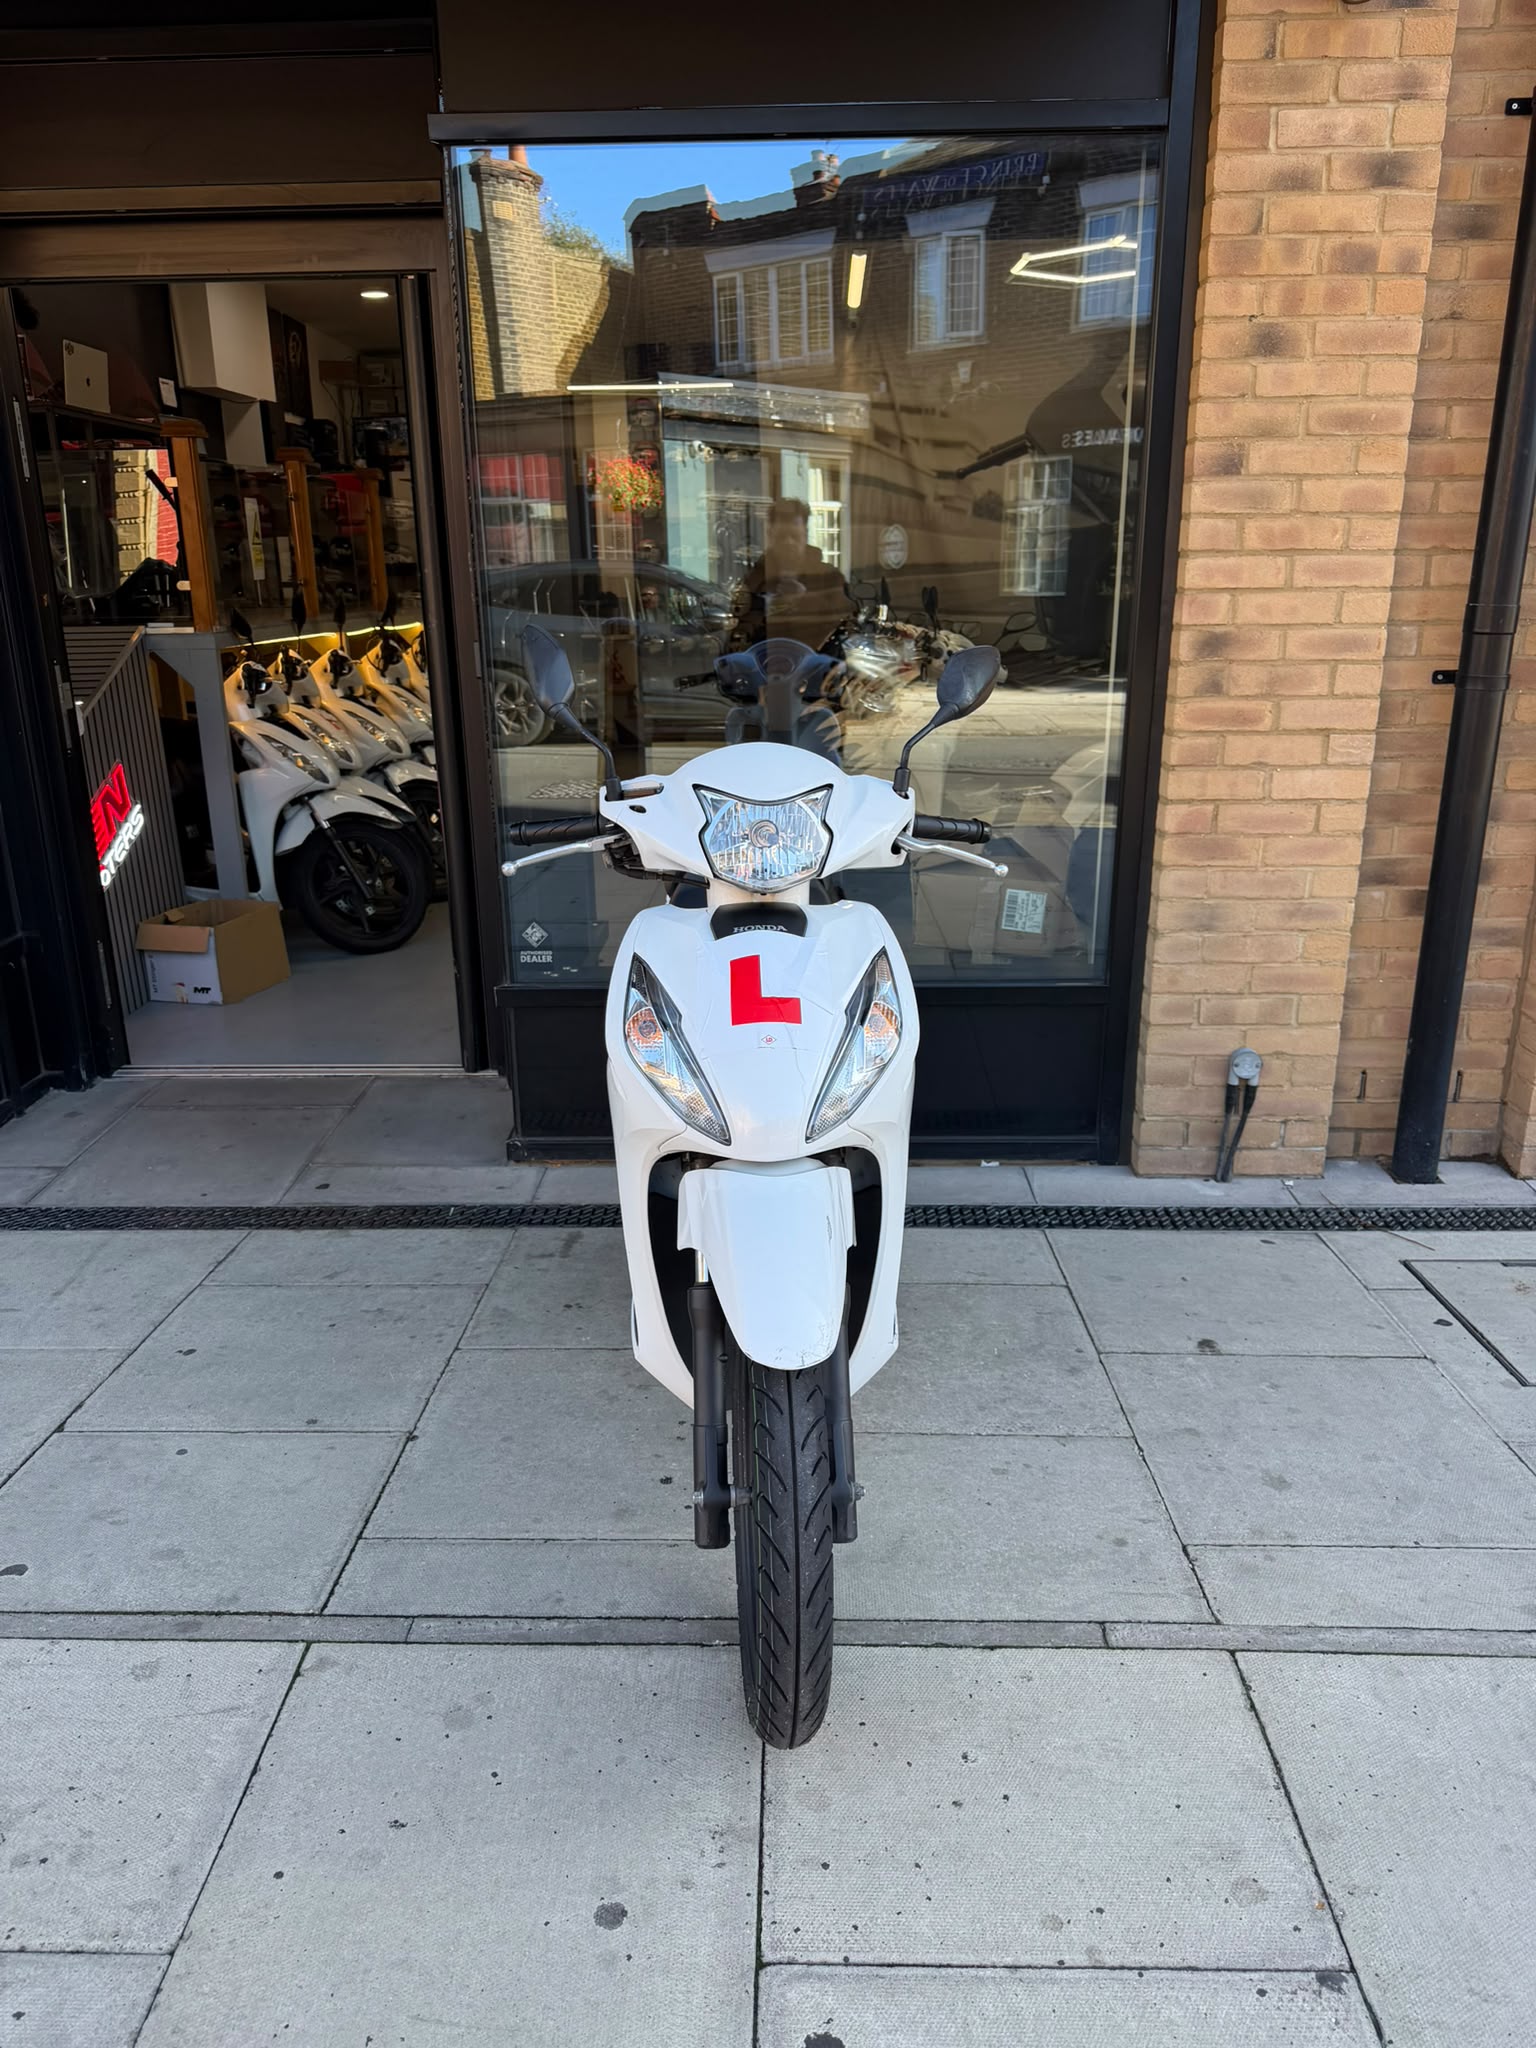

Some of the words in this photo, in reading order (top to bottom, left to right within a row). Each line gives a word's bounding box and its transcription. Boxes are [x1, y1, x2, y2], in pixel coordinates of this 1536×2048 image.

[732, 924, 788, 933] HONDA
[520, 955, 553, 963] DEALER
[193, 986, 211, 994] MT
[730, 954, 802, 1026] L
